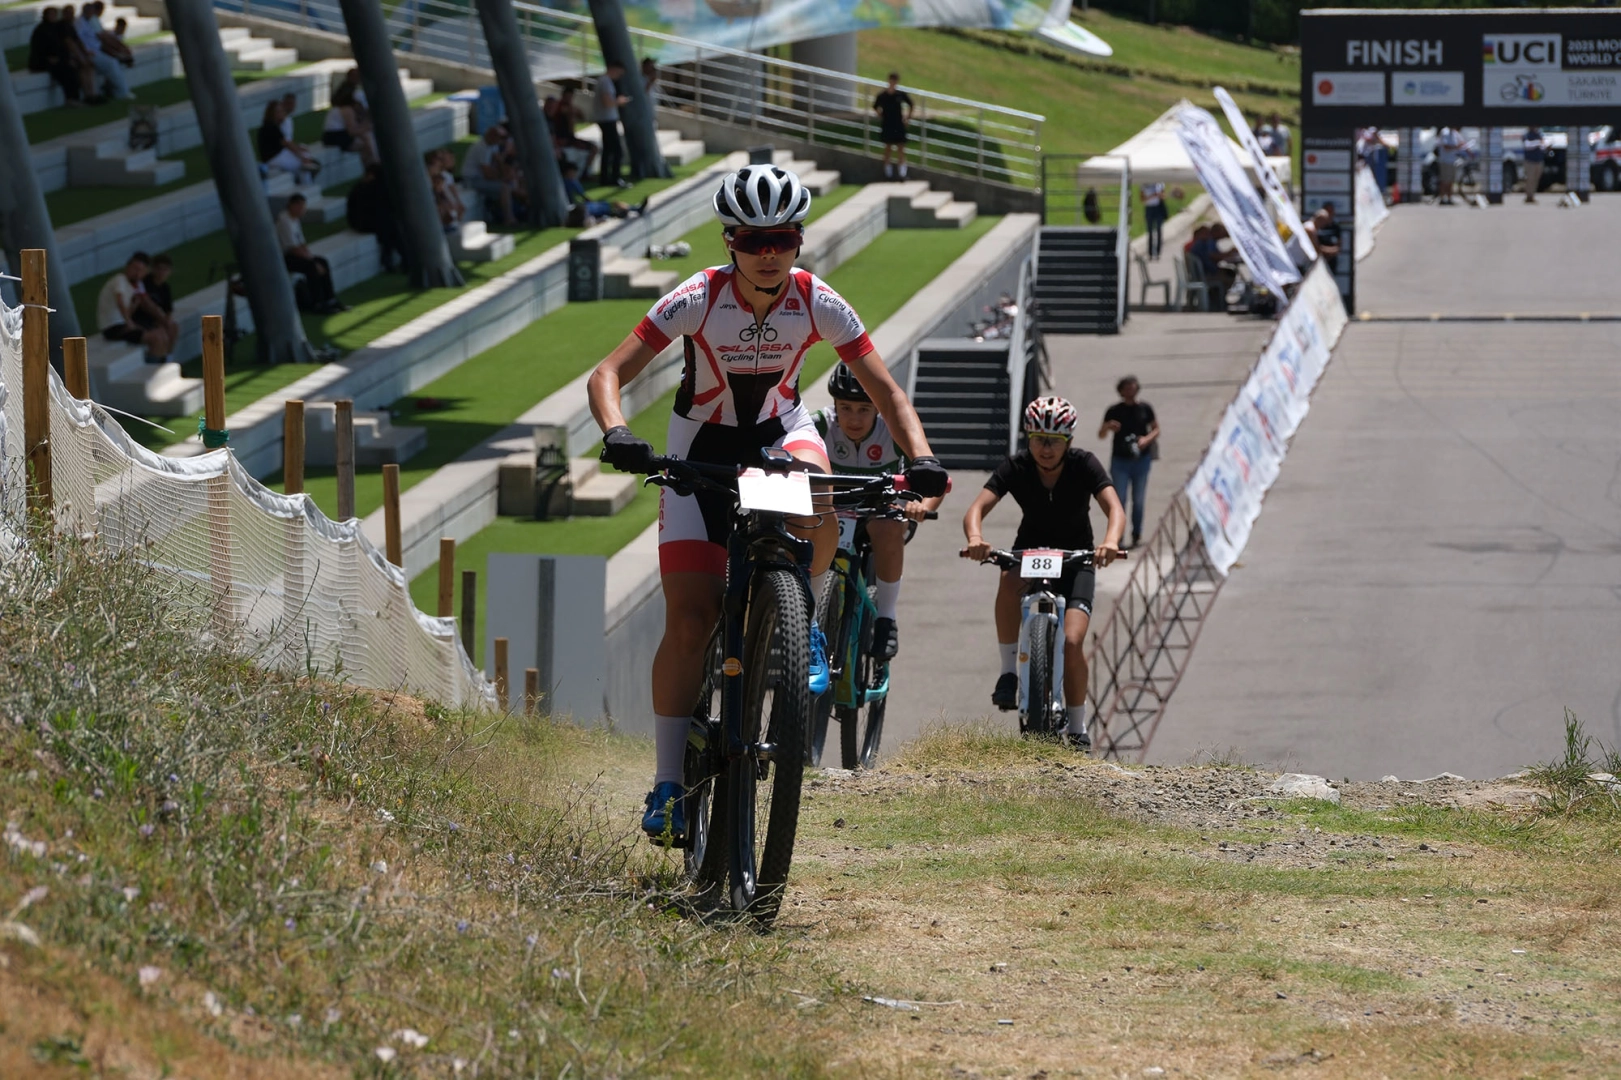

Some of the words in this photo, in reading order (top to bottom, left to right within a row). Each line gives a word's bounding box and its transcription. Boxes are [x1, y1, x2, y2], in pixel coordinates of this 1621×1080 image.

[1346, 39, 1443, 65] FINISH
[1497, 41, 1555, 64] UCI
[1596, 39, 1621, 52] MO
[1567, 52, 1613, 65] WORLD
[664, 281, 706, 306] LASSA
[663, 298, 687, 321] Cycling
[818, 293, 846, 311] Cycling
[733, 343, 793, 353] LASSA
[720, 353, 755, 362] Cycling
[1032, 558, 1052, 570] 88
